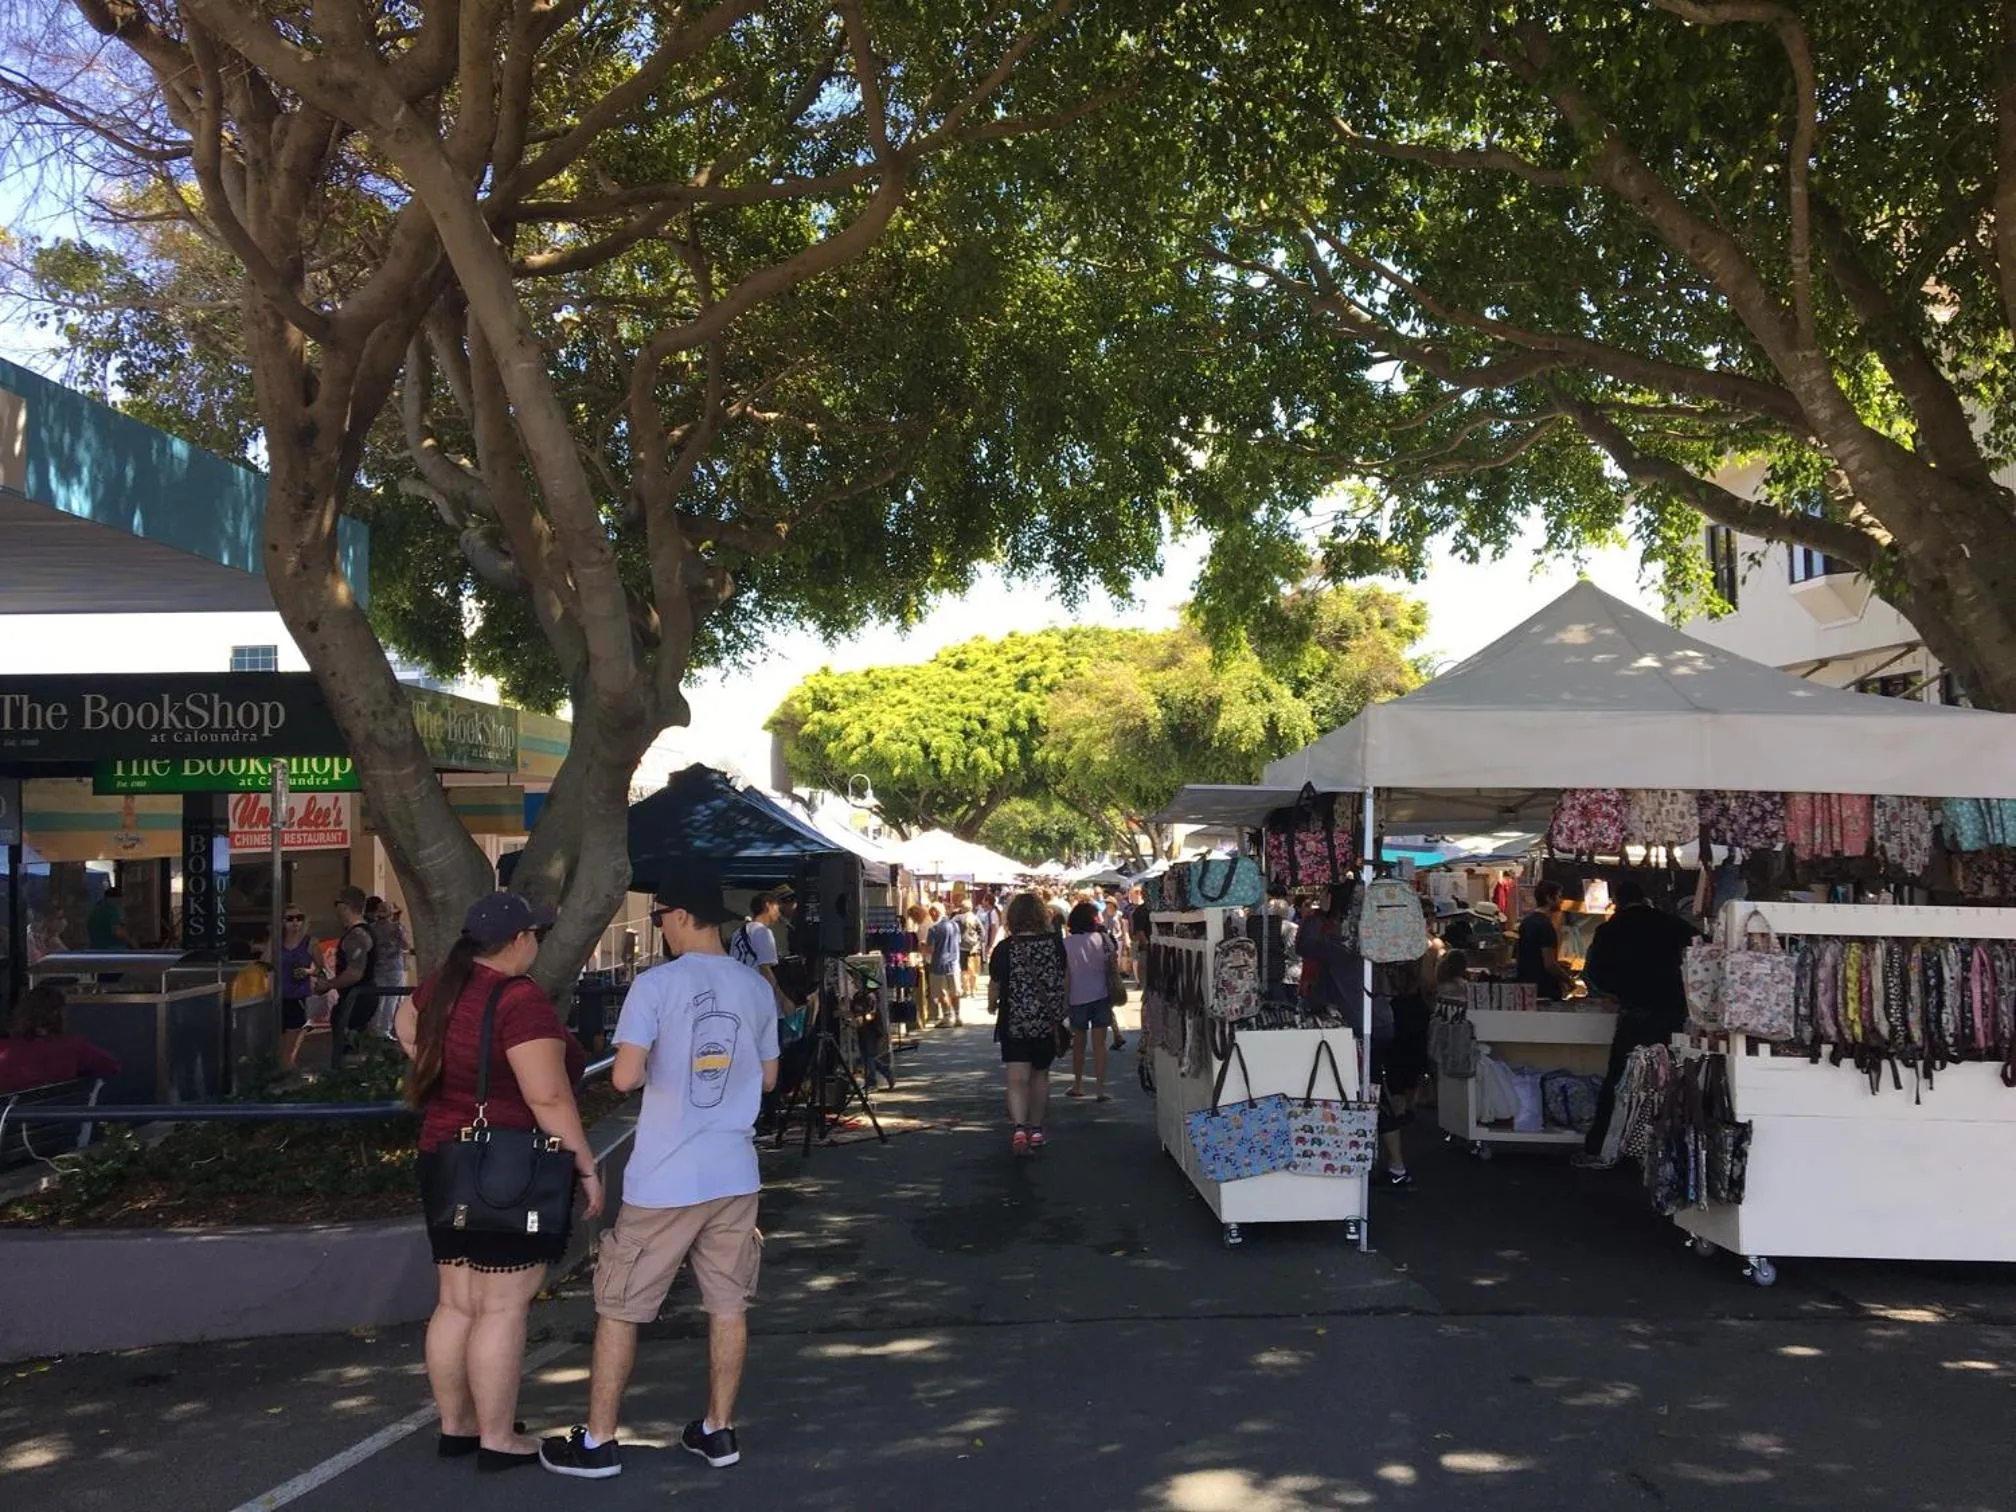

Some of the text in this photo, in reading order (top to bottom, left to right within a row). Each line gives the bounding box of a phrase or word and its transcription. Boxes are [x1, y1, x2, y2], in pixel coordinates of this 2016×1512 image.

[0, 692, 286, 737] The BookShop
[412, 701, 515, 757] The BookShop
[150, 730, 258, 743] at Caloundra
[113, 757, 353, 780] The Bookhop
[239, 775, 329, 786] at Caundra
[232, 793, 343, 829] Une Lee's
[234, 832, 343, 847] CHINES RESTAURANT
[188, 835, 208, 936] BOOKS
